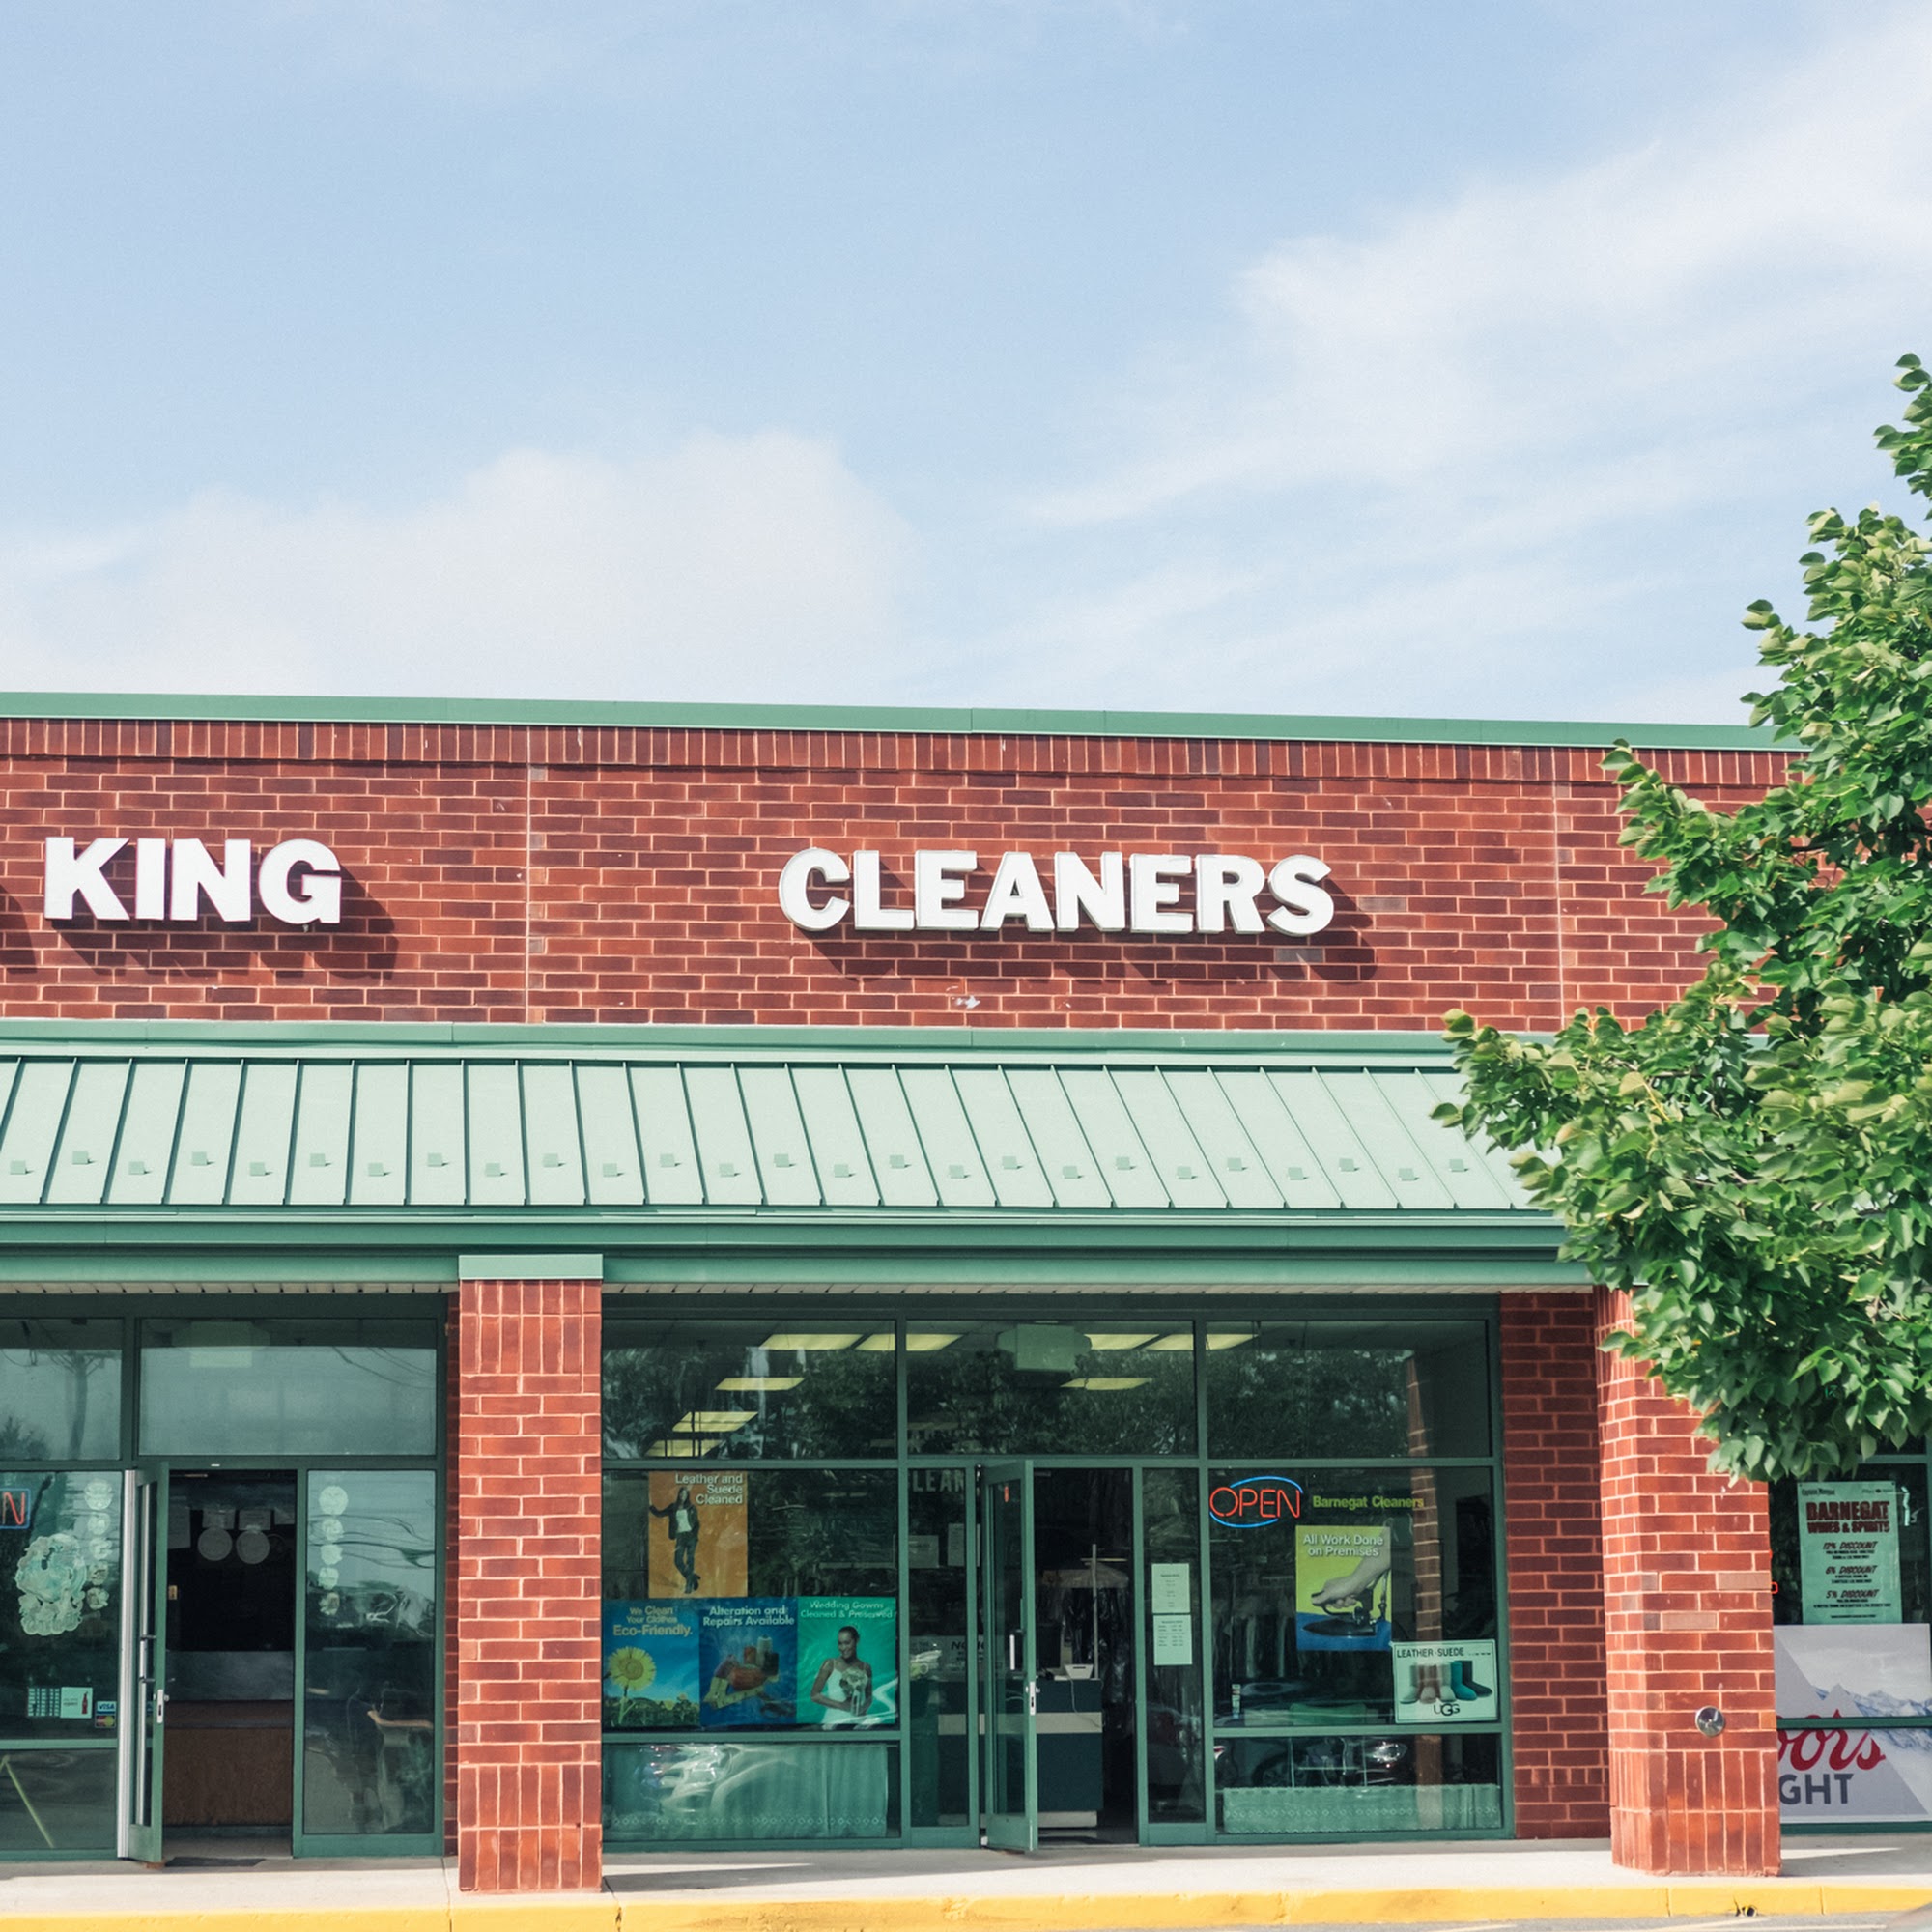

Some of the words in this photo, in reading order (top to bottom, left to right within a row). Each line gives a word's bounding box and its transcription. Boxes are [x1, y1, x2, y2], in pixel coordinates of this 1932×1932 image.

[44, 837, 342, 924] KING
[778, 847, 1335, 937] CLEANERS
[675, 1473, 719, 1485] Leather
[722, 1473, 743, 1484] and
[908, 1469, 965, 1492] LEAN
[706, 1484, 743, 1494] Suede
[696, 1493, 743, 1505] Cleaned
[1209, 1487, 1300, 1519] OPEN
[1312, 1495, 1368, 1511] Barnegat
[1371, 1496, 1425, 1509] Cleaners
[1805, 1500, 1890, 1521] BARNEGAT
[1303, 1534, 1318, 1545] All
[1321, 1534, 1351, 1545] Work
[1353, 1534, 1383, 1545] Done
[1308, 1548, 1323, 1557] on
[1325, 1546, 1379, 1557] Premises
[644, 1605, 674, 1615] Clean
[709, 1605, 761, 1616] Alteration
[763, 1605, 786, 1615] and
[800, 1609, 837, 1618] Cleaned
[702, 1615, 743, 1629] Repairs
[745, 1614, 795, 1626] Available
[612, 1622, 694, 1637] Eco-Friendly.
[1397, 1648, 1434, 1659] LEATHER
[1436, 1646, 1464, 1657] SUEDE
[1433, 1702, 1461, 1717] UGG
